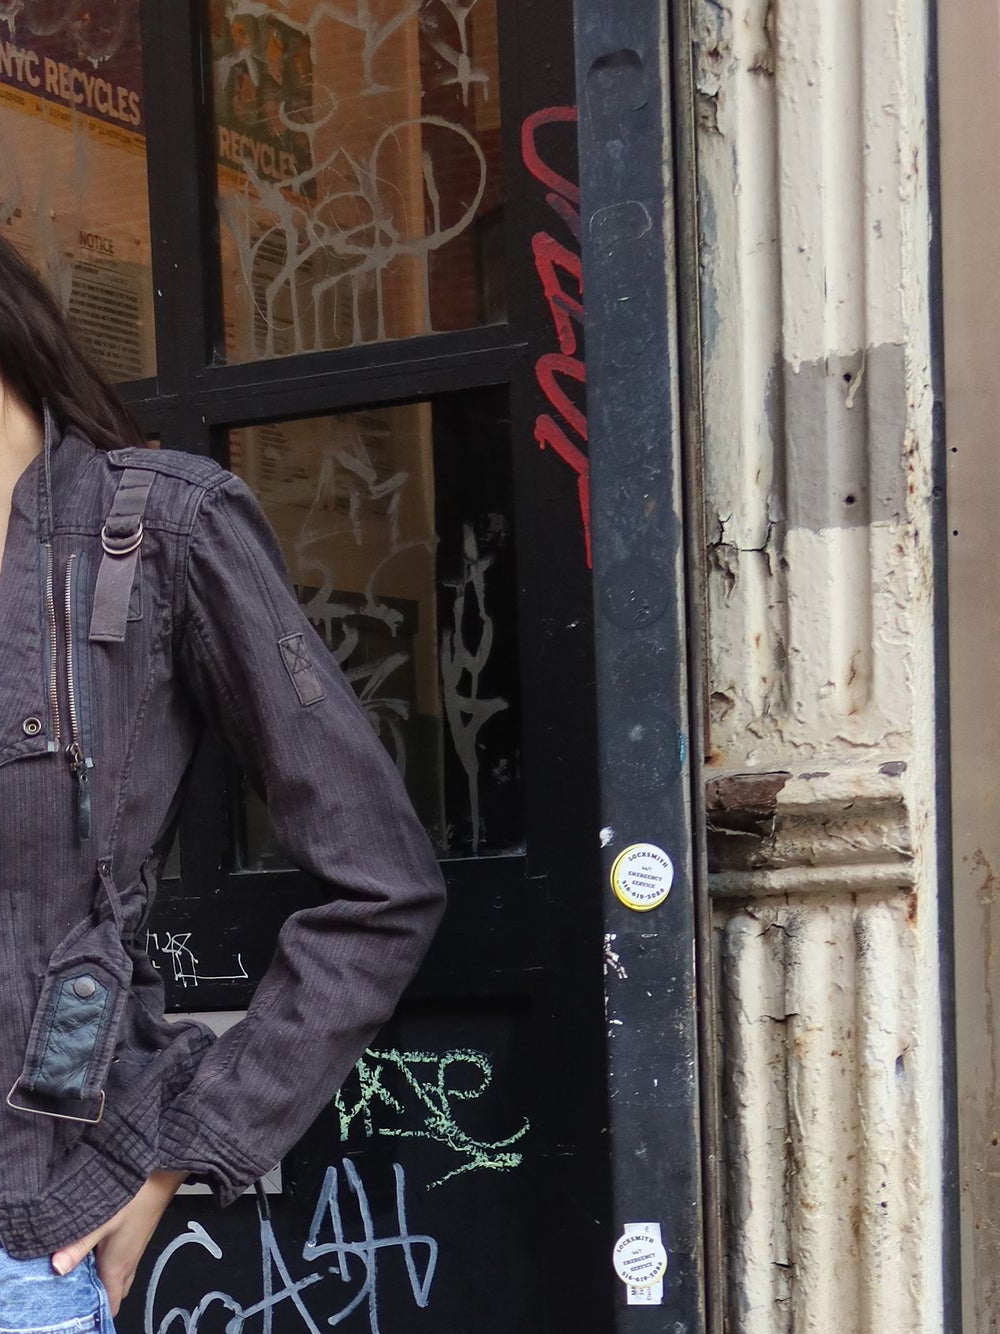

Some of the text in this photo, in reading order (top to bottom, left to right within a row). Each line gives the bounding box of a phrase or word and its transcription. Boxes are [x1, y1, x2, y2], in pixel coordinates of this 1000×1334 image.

[44, 57, 141, 126] RECYCLES
[79, 230, 115, 254] NOTICE
[629, 852, 668, 868] LOCKSMITH
[628, 871, 662, 881] EMERGENCY
[632, 880, 655, 889] SERVICE
[616, 1236, 655, 1253] LOCKSMITH
[623, 1253, 655, 1265] EMERGENCY
[630, 1262, 652, 1272] SERVICE
